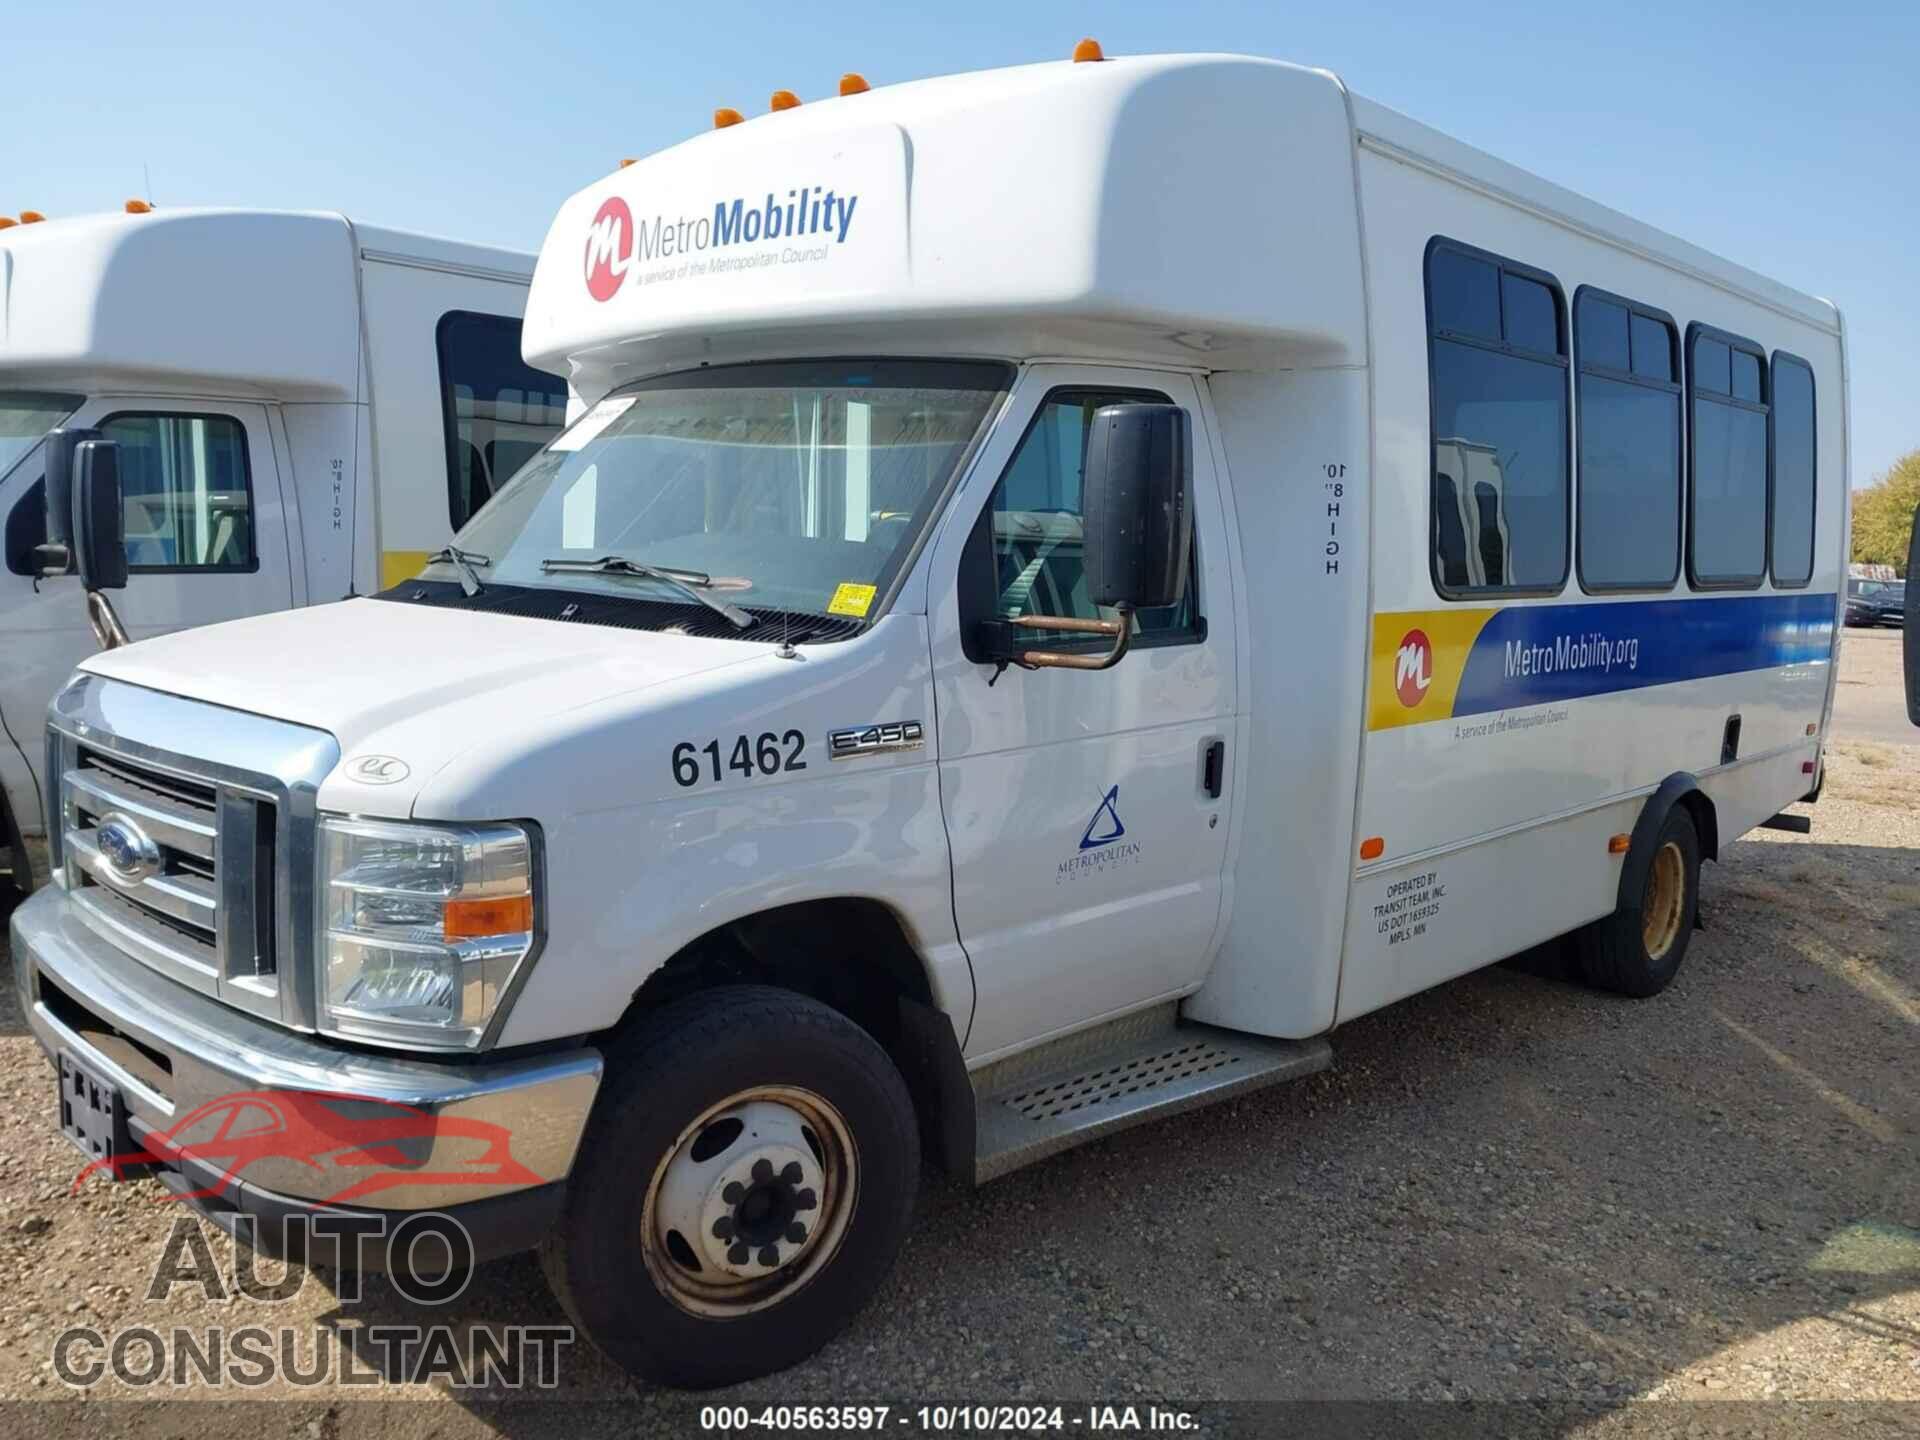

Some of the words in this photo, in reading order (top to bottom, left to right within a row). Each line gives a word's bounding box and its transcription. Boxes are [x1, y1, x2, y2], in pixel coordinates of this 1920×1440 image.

[637, 186, 858, 263] MetroMobility
[708, 250, 778, 273] Metropolitan
[781, 244, 829, 265] Council
[1503, 632, 1639, 678] MetroMobility.org
[671, 728, 807, 787] 61462
[1057, 840, 1141, 873] METROPOLITAN
[1386, 875, 1426, 898] OPERATED
[1427, 872, 1438, 886] BY
[1374, 897, 1408, 918] TRANSIT
[1377, 919, 1390, 933] US
[1390, 912, 1408, 930] DOT
